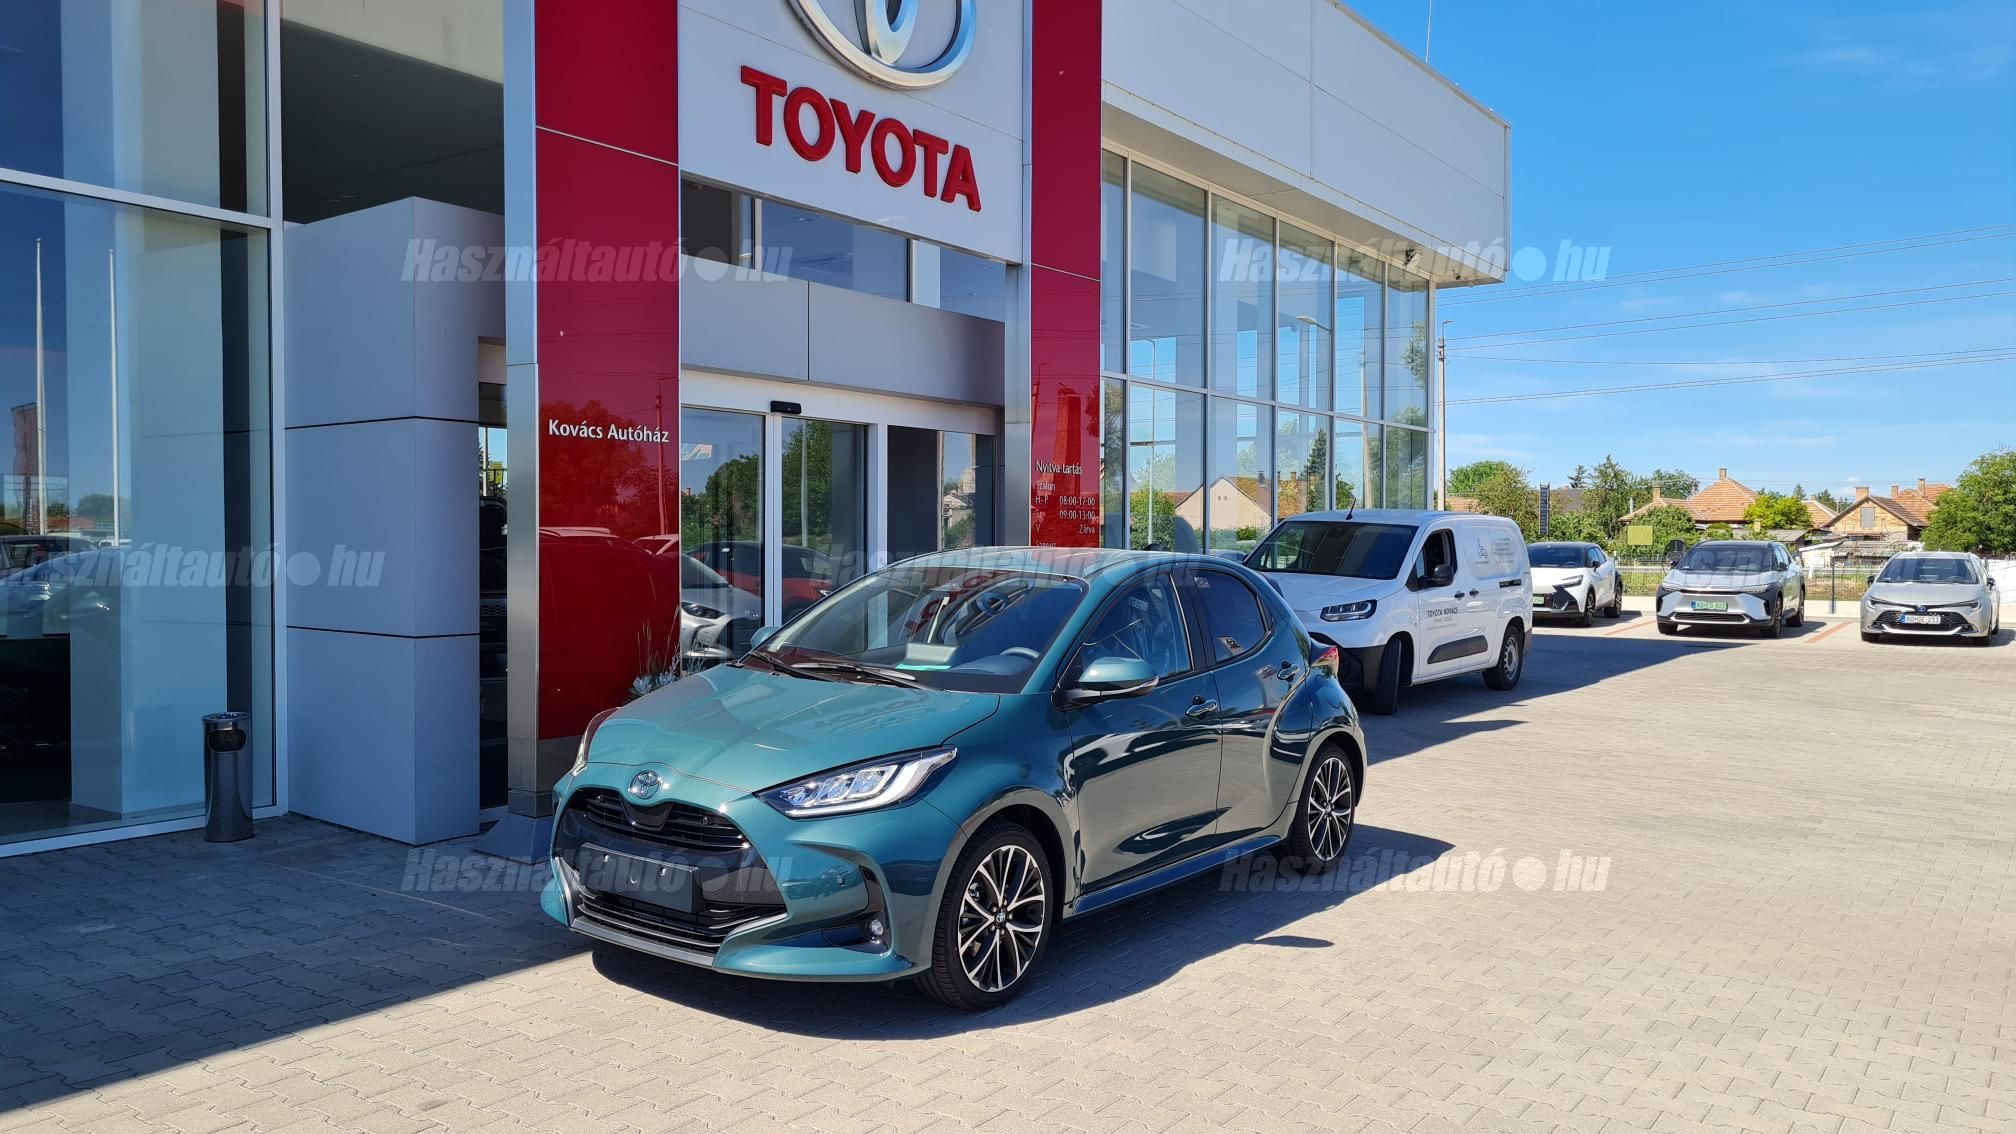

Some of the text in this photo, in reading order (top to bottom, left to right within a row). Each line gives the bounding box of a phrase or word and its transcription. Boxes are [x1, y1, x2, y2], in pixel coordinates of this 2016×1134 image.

[740, 65, 982, 213] TOYOTA
[548, 419, 670, 442] Kovács Autóház
[1036, 460, 1083, 476] Nyitva tartás
[1079, 524, 1096, 534] Zárva
[1427, 609, 1443, 618] TOYOTA
